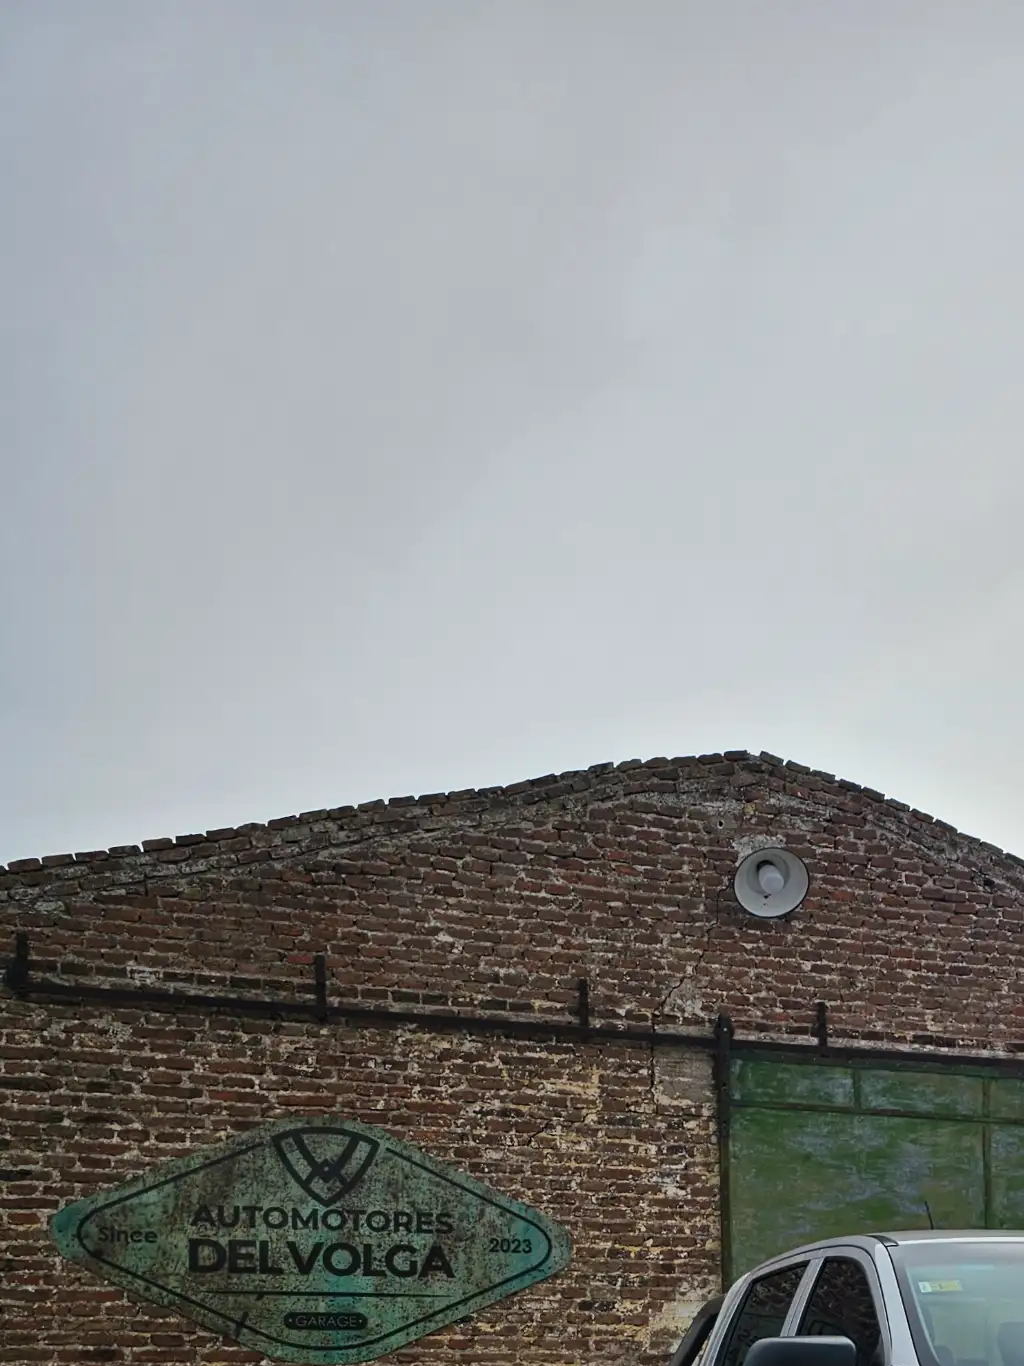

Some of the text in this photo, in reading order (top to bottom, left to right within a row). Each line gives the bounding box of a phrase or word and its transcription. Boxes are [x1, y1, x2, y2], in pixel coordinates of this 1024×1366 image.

[190, 1205, 454, 1234] AUTOMOTORES
[98, 1226, 158, 1244] Since
[489, 1238, 533, 1254] 2023
[295, 1315, 358, 1328] GARAGE
